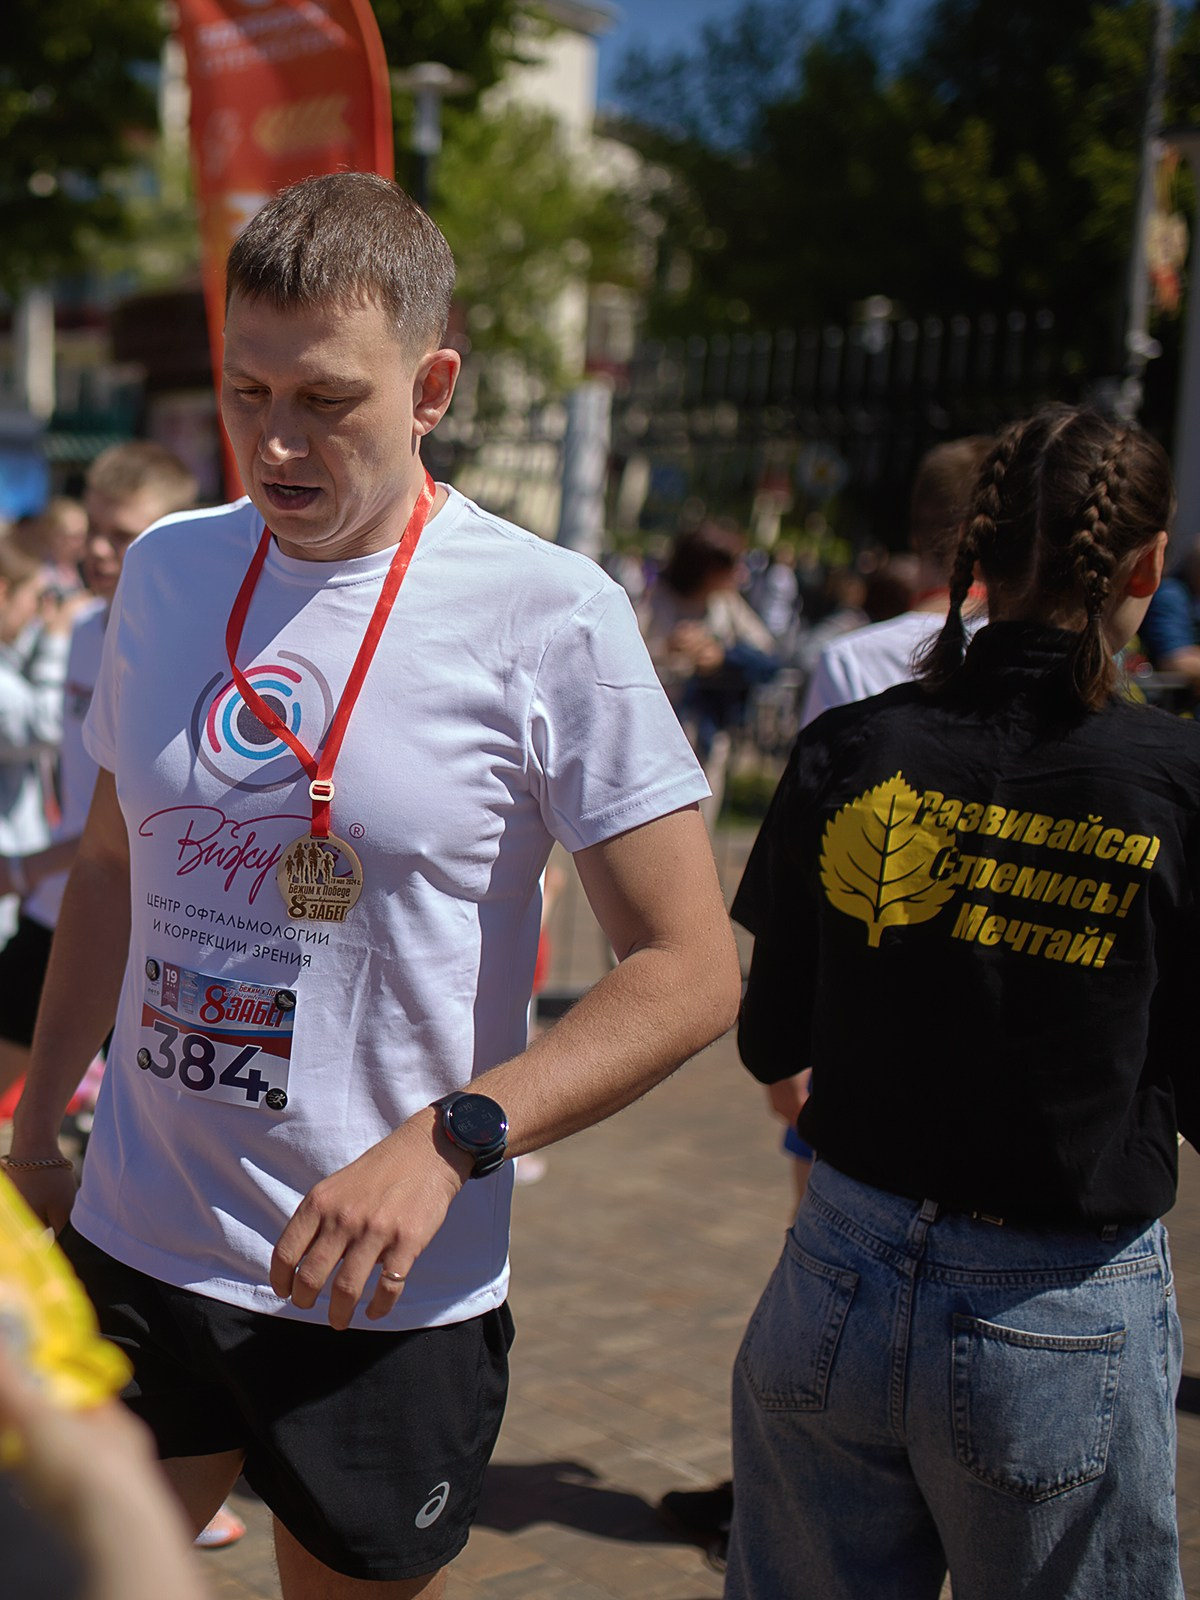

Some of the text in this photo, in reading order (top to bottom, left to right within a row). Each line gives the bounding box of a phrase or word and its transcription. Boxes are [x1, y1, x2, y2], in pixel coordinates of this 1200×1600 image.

[912, 790, 1161, 870] Развивайся!
[288, 894, 307, 918] 8
[308, 904, 348, 921] ЗАБЕГ
[315, 887, 321, 895] к
[322, 885, 351, 898] Победе
[929, 845, 1140, 919] Стремись!
[146, 892, 330, 946] ЦЕНТР ОФТАЛЬМОЛОГИИ
[153, 918, 312, 968] И КОРРЕКЦИИ ЗРЕНИЯ
[951, 902, 1117, 969] Мечтай!
[165, 968, 178, 984] 19
[199, 984, 228, 1024] 8
[149, 1020, 270, 1103] 384
